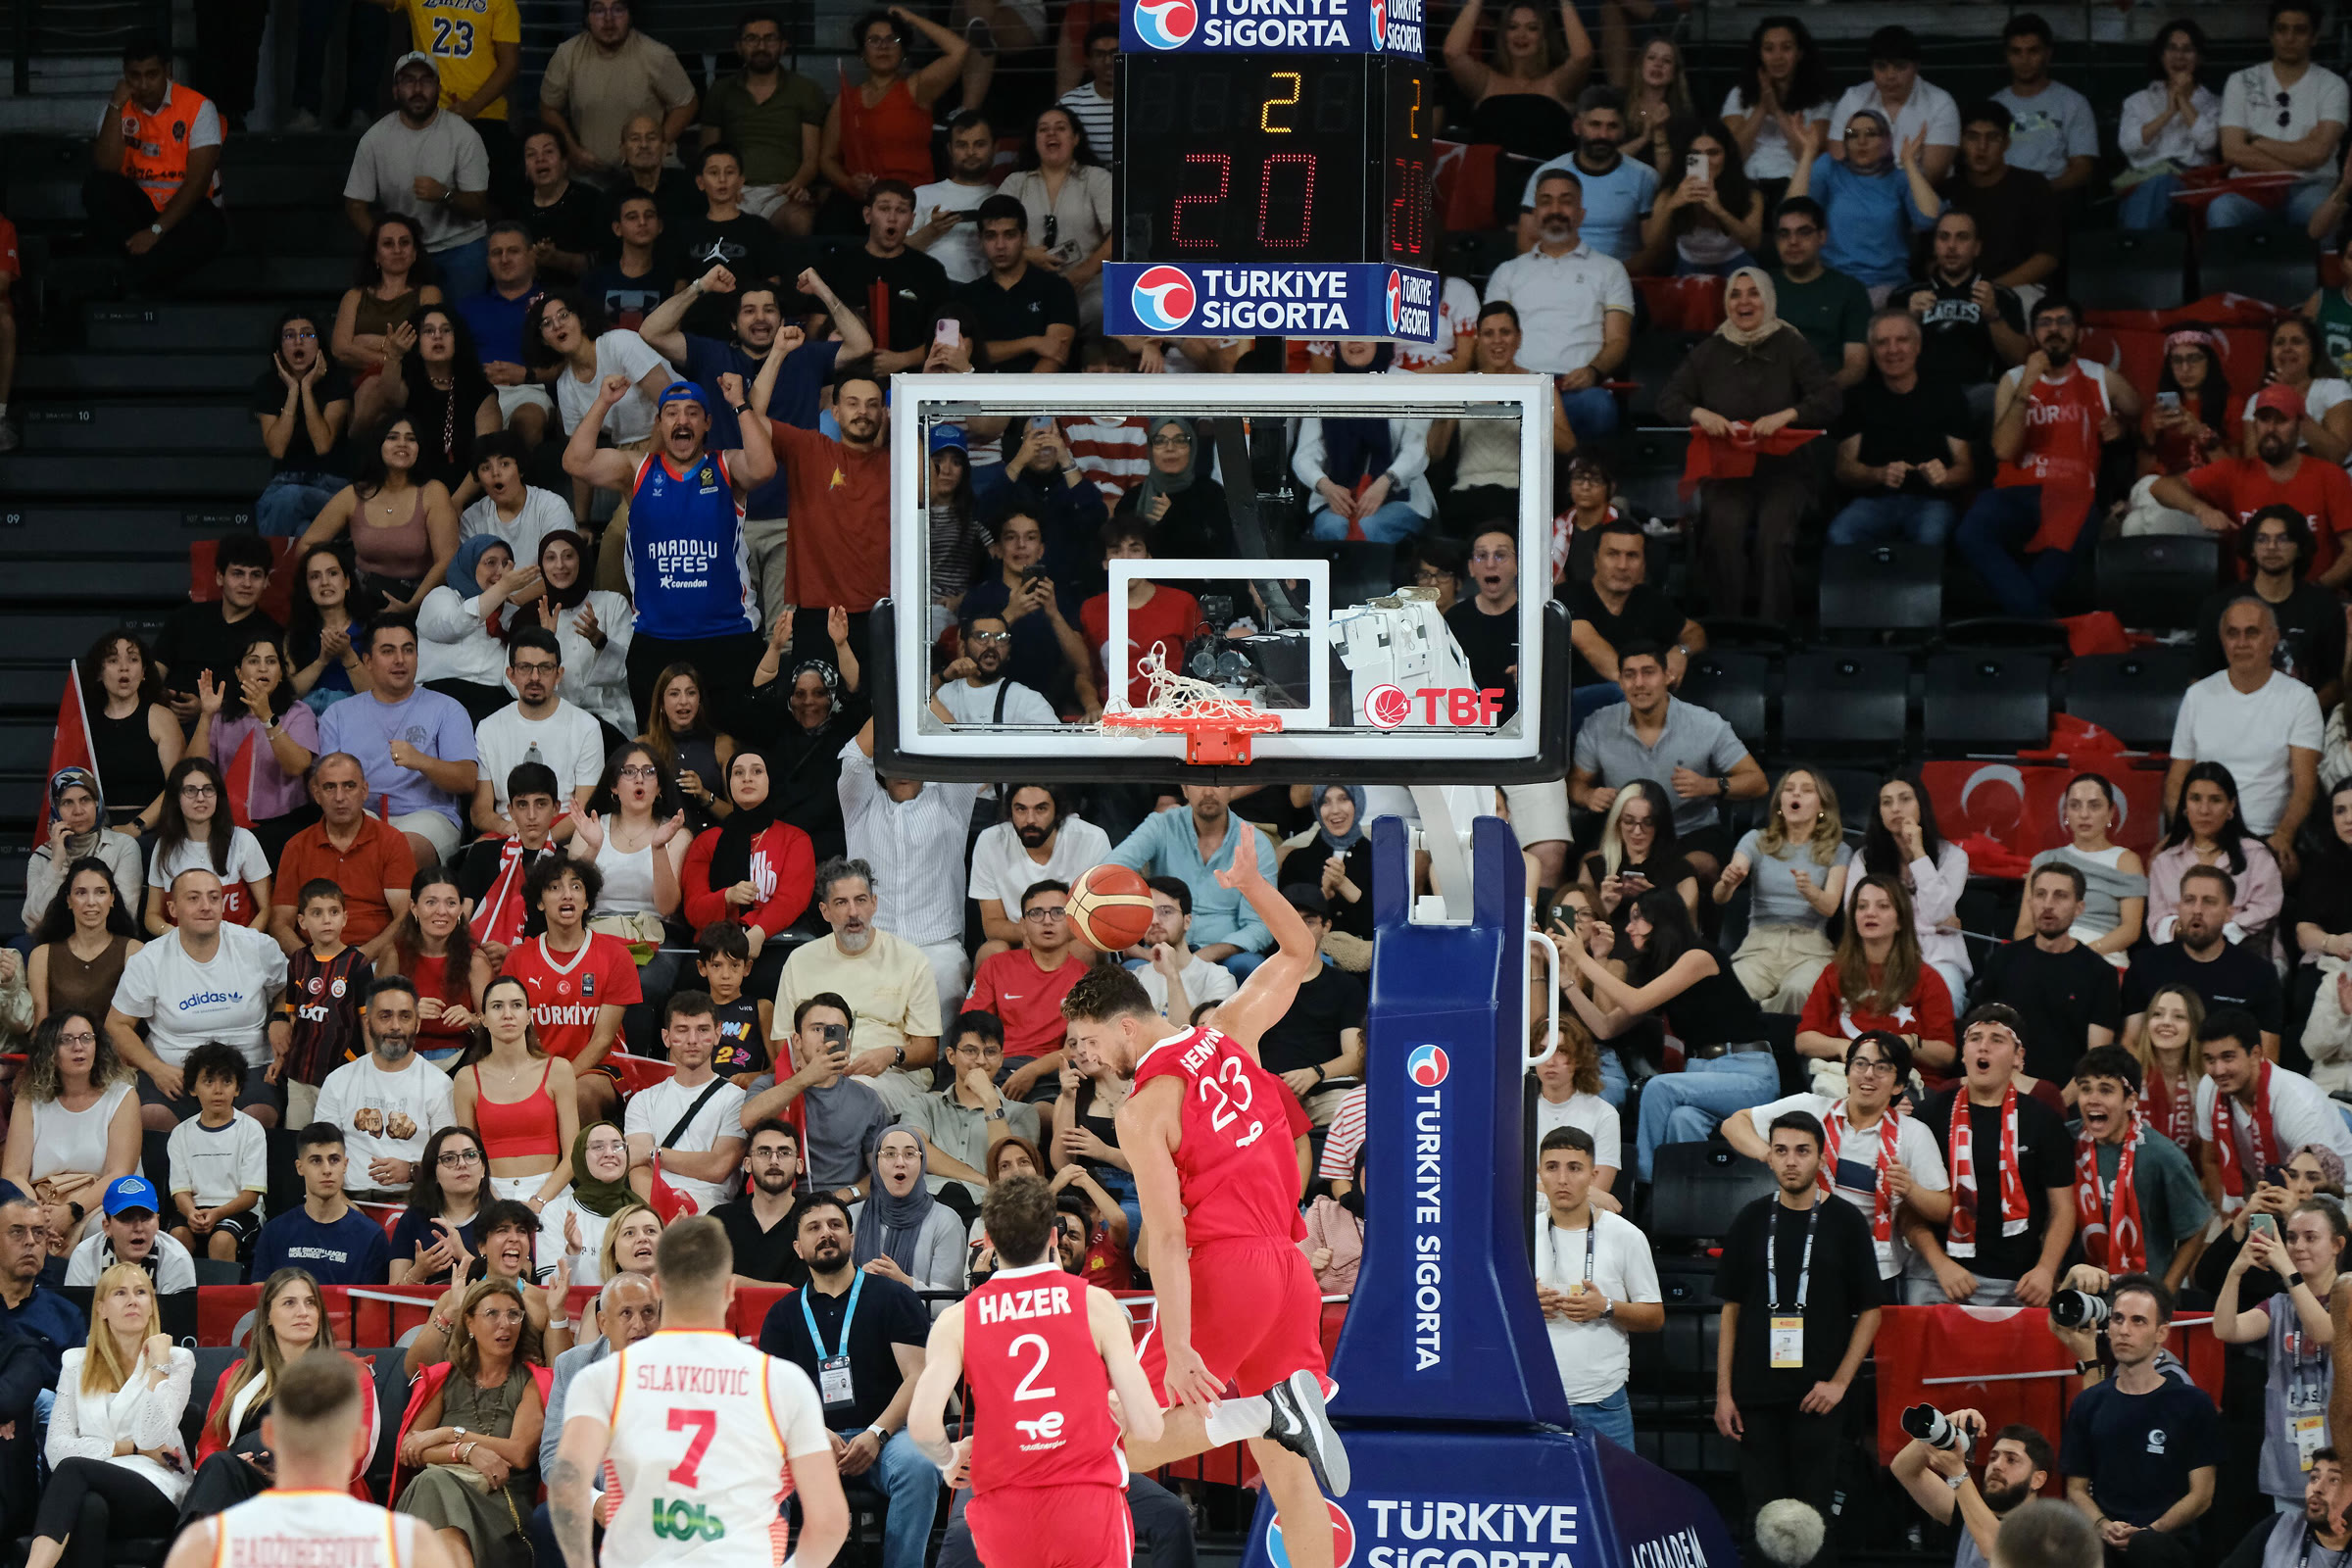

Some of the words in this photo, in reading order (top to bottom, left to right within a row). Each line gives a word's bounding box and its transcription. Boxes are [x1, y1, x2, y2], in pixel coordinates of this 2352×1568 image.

[431, 16, 475, 60] 23
[1260, 72, 1301, 133] 2
[1171, 154, 1317, 247] 20
[78, 411, 91, 421] 10
[6, 514, 21, 524] 09
[235, 514, 249, 524] 09
[648, 539, 718, 560] ANADOLU
[659, 557, 709, 573] EFES
[670, 576, 709, 589] corendon
[1415, 688, 1506, 726] TBF
[179, 991, 227, 1010] adidas
[714, 1046, 753, 1068] 22
[1199, 1055, 1254, 1134] 23
[978, 1286, 1072, 1326] HAZER
[638, 1363, 751, 1396] SLAVKOVIĆ
[1007, 1333, 1056, 1402] 2
[666, 1406, 717, 1490] 7
